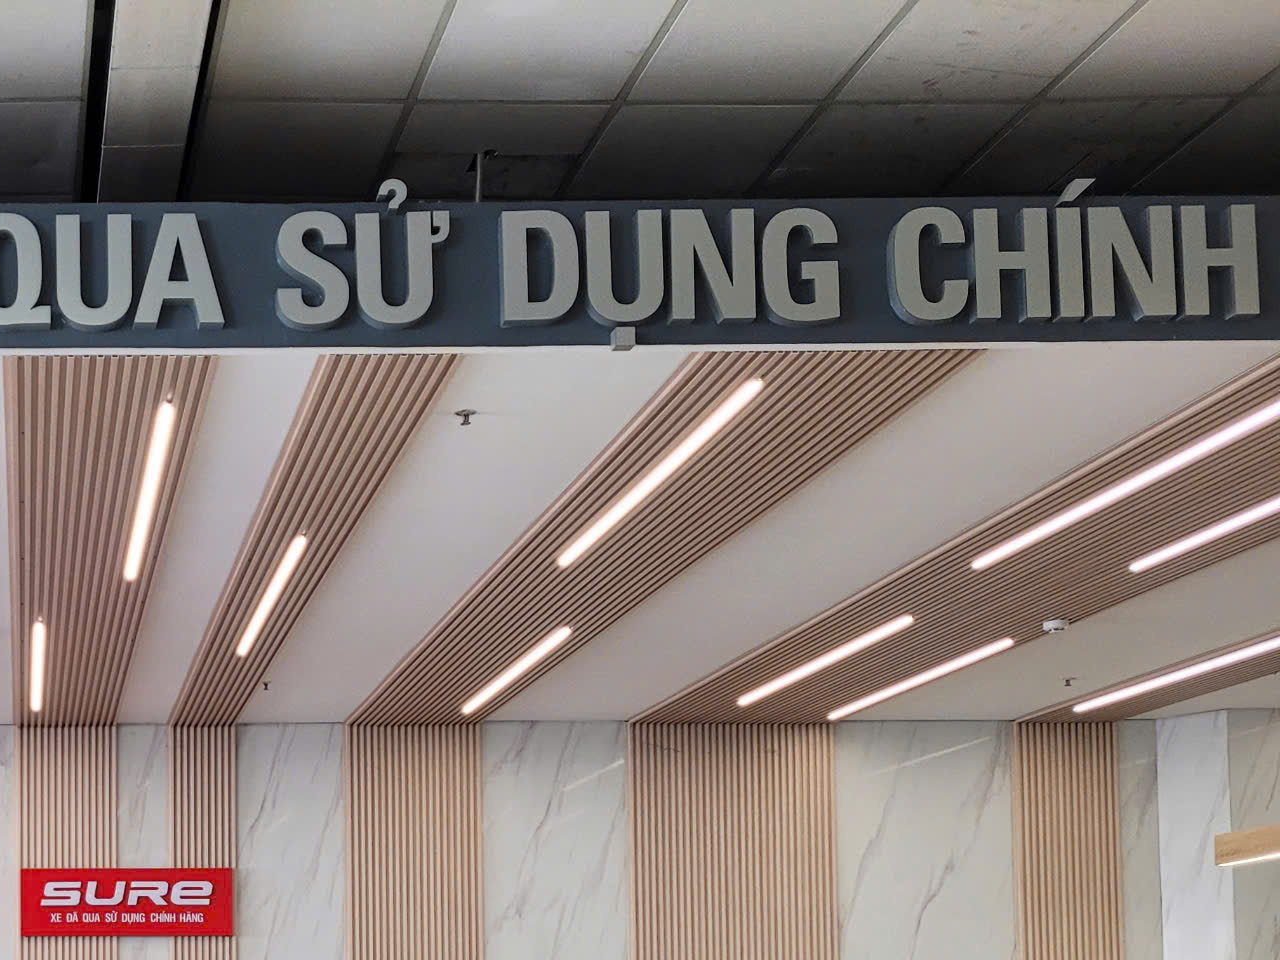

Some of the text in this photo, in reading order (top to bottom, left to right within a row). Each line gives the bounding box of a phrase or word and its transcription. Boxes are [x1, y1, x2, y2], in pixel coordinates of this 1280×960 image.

[274, 179, 451, 330] SỬ
[500, 206, 842, 350] DỤNG
[887, 178, 1261, 326] CHÍNH
[50, 911, 62, 923] XE
[82, 911, 101, 923] QUA
